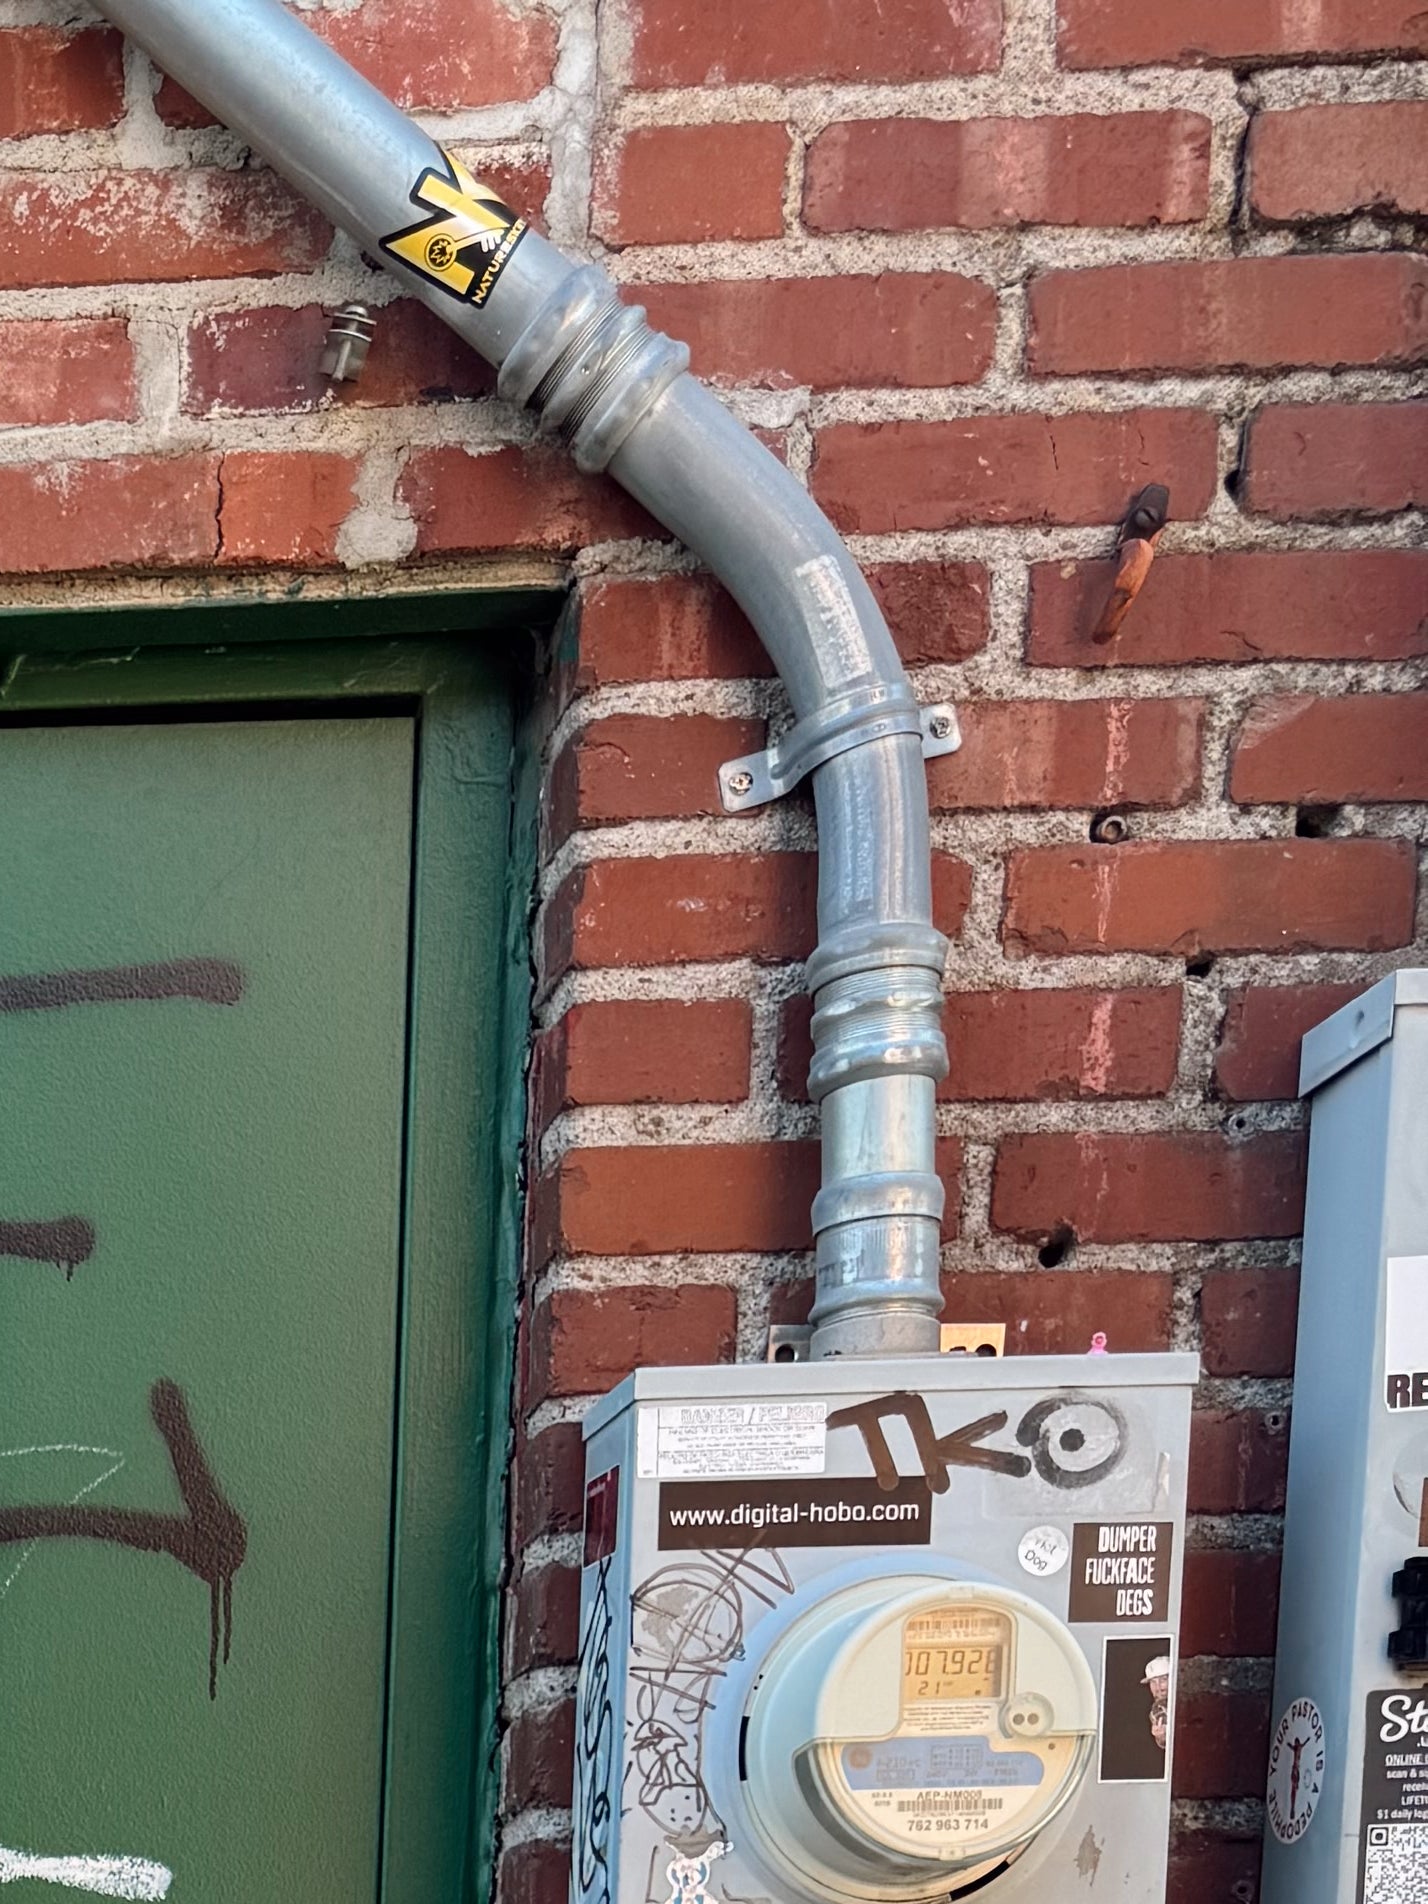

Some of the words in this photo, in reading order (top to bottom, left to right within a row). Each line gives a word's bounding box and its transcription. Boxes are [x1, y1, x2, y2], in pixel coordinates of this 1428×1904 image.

[669, 1501, 920, 1529] www.digital-hobo.com
[1098, 1525, 1157, 1553] DUMPER
[1085, 1557, 1156, 1585] FUCKFACE
[1116, 1588, 1154, 1616] DEGS
[1292, 1702, 1323, 1741] PASTOR
[1269, 1719, 1289, 1776] YOUR
[1385, 1754, 1421, 1766] ONLINE
[1386, 1769, 1408, 1779] scan
[936, 1819, 960, 1832] 963
[964, 1818, 989, 1831] 714
[1269, 1789, 1313, 1840] PEDOPHILE
